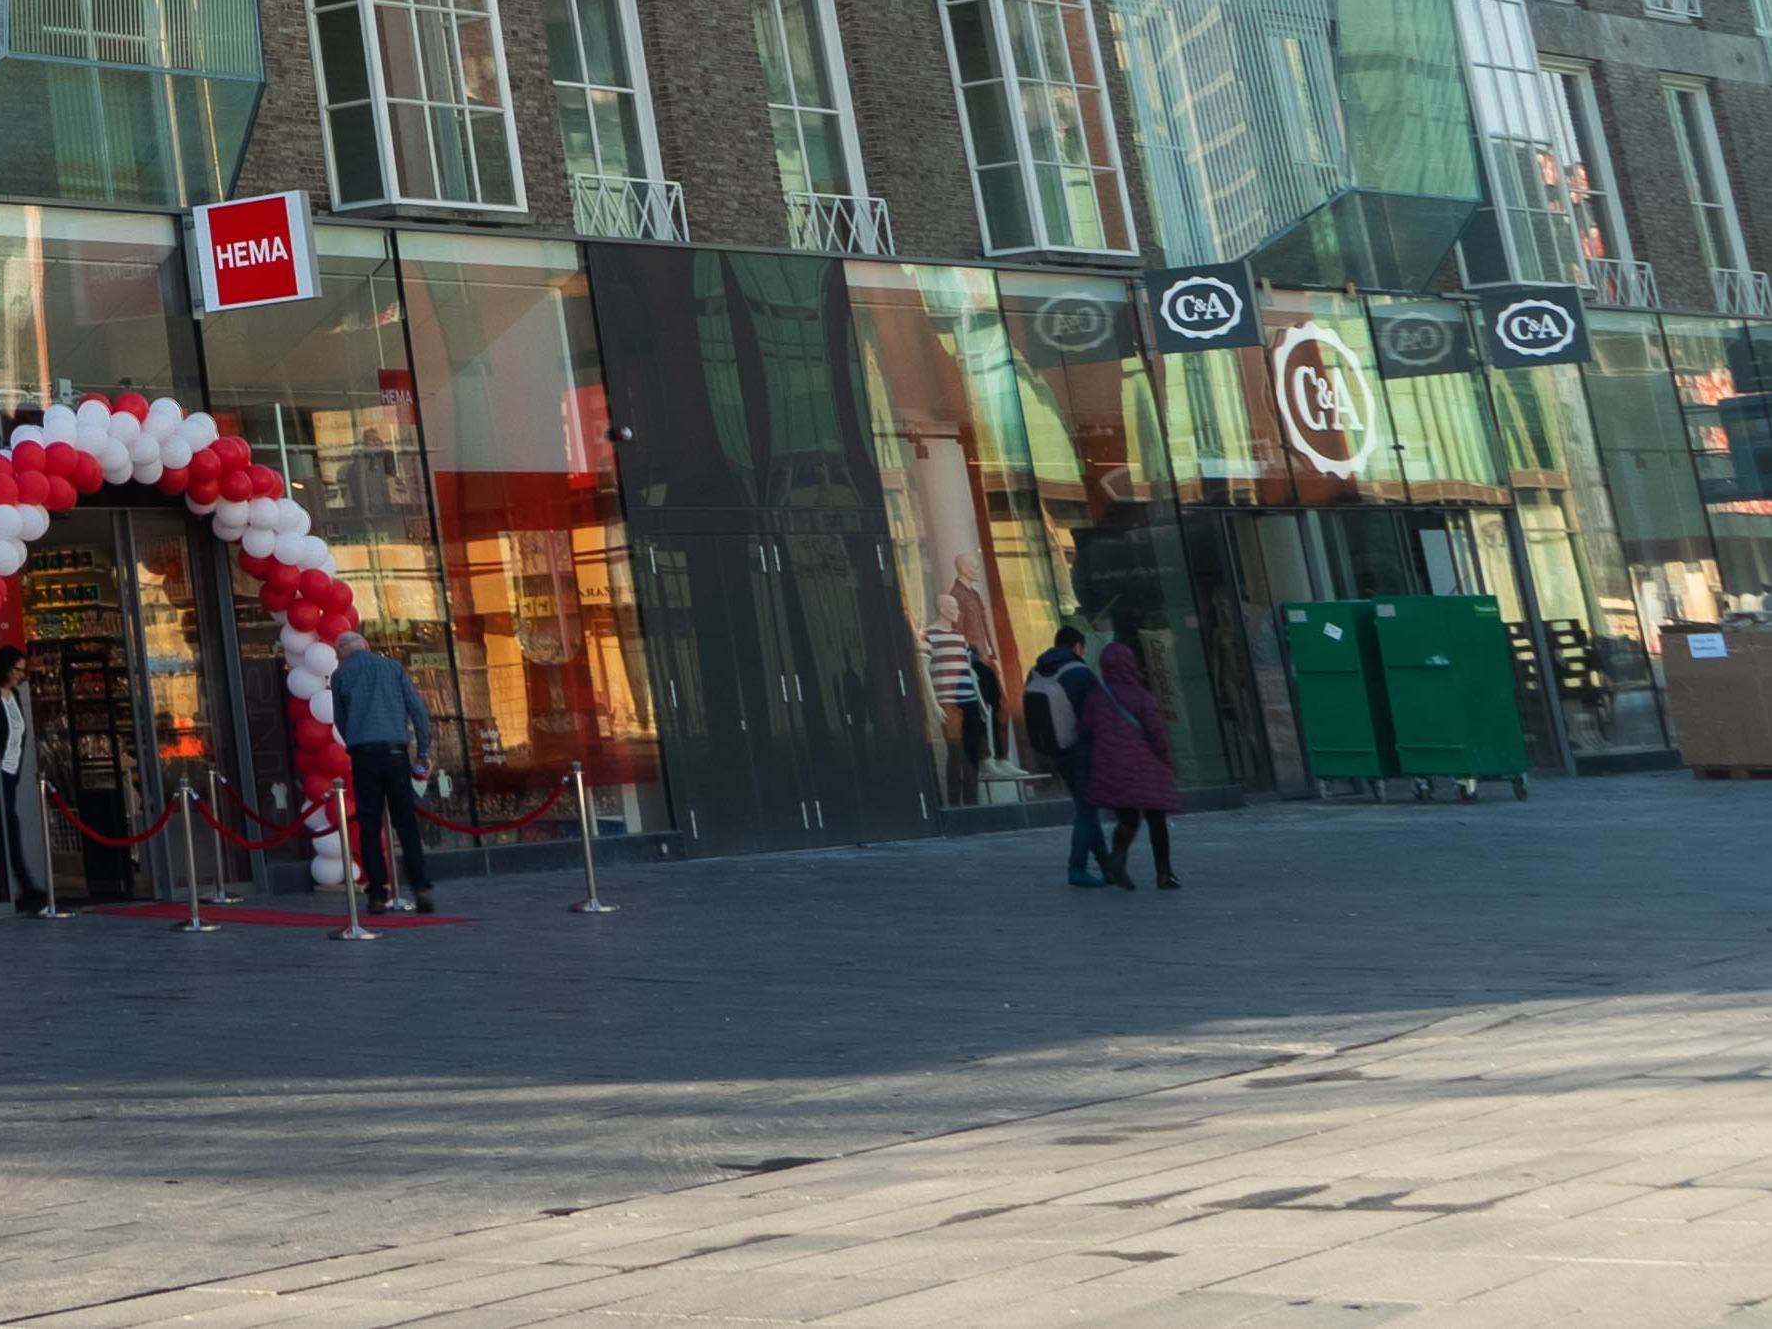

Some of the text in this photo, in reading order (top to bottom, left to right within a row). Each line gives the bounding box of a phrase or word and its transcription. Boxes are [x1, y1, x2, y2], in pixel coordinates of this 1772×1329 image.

[216, 236, 288, 270] HEMA
[1175, 292, 1230, 321] C&A
[1510, 314, 1563, 340] C&A
[381, 390, 413, 406] HEMA
[1292, 365, 1363, 431] C&A
